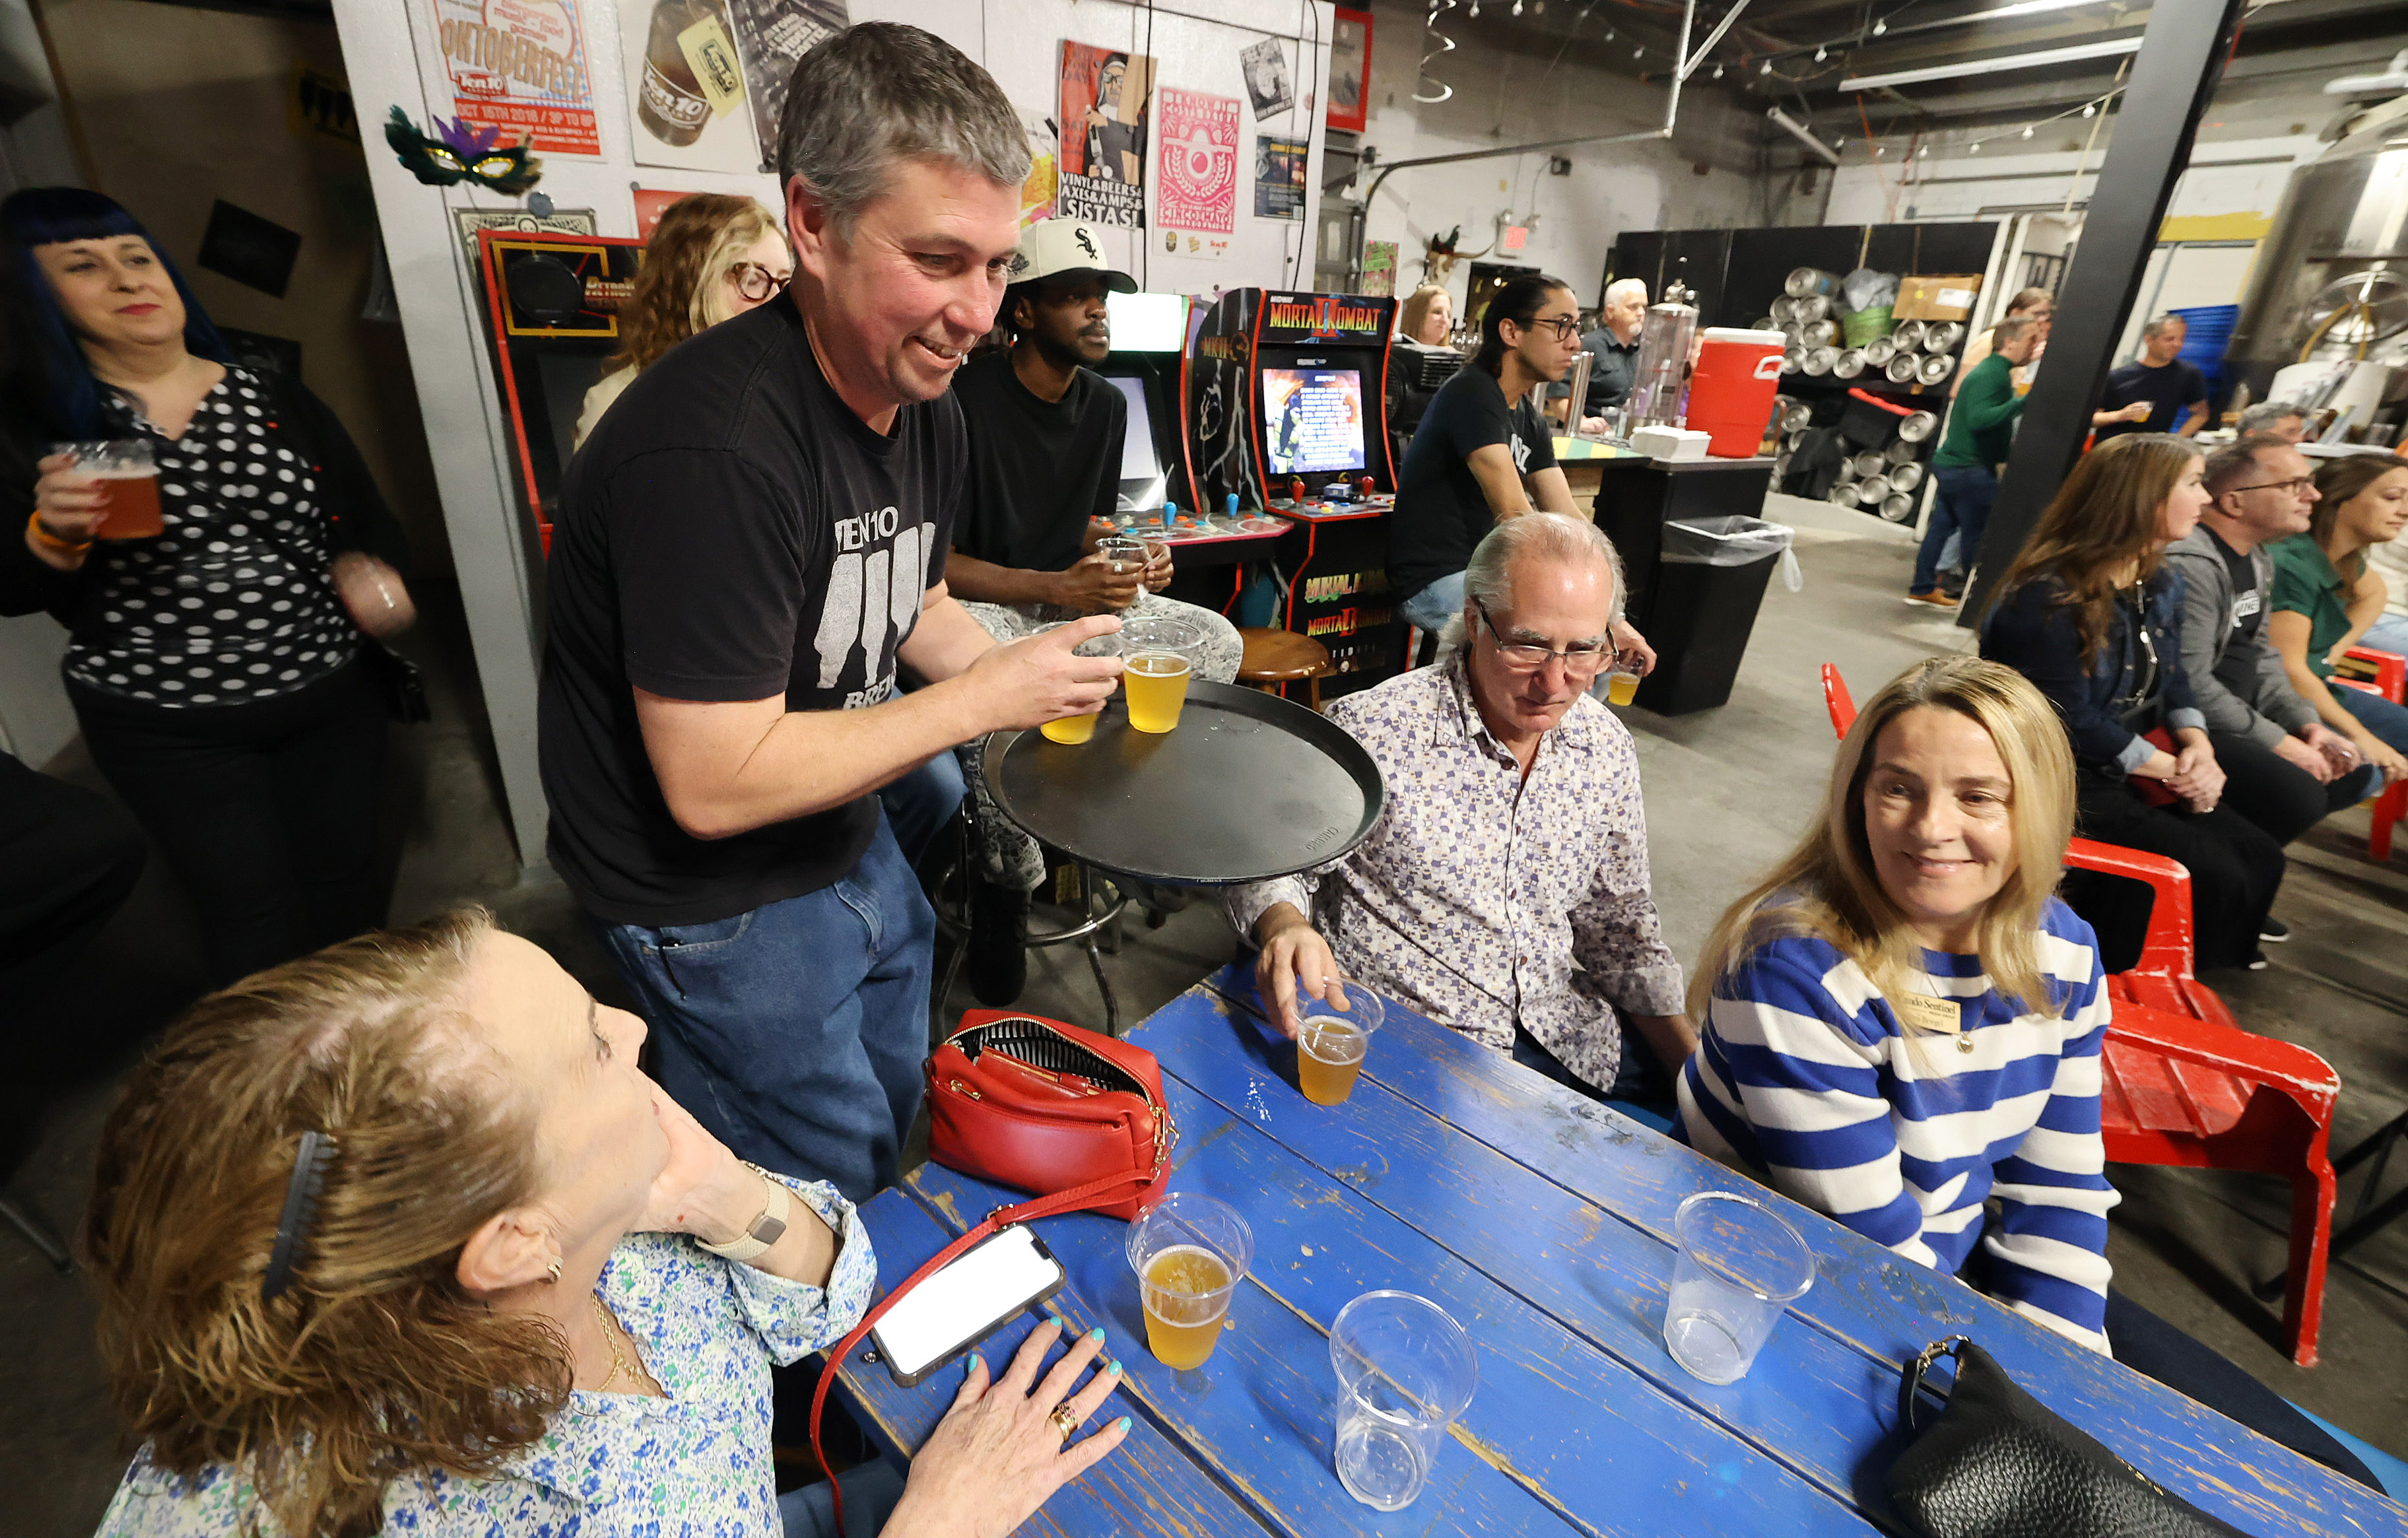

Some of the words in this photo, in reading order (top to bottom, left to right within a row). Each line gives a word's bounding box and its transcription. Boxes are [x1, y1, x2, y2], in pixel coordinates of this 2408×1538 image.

[441, 18, 584, 100] OKTOBERFEST
[1066, 198, 1139, 230] SISTAS!
[1075, 227, 1098, 260] Sox
[1269, 302, 1323, 329] MORTAL
[1325, 305, 1381, 332] KOMBAT
[1923, 999, 1956, 1015] Sentinel
